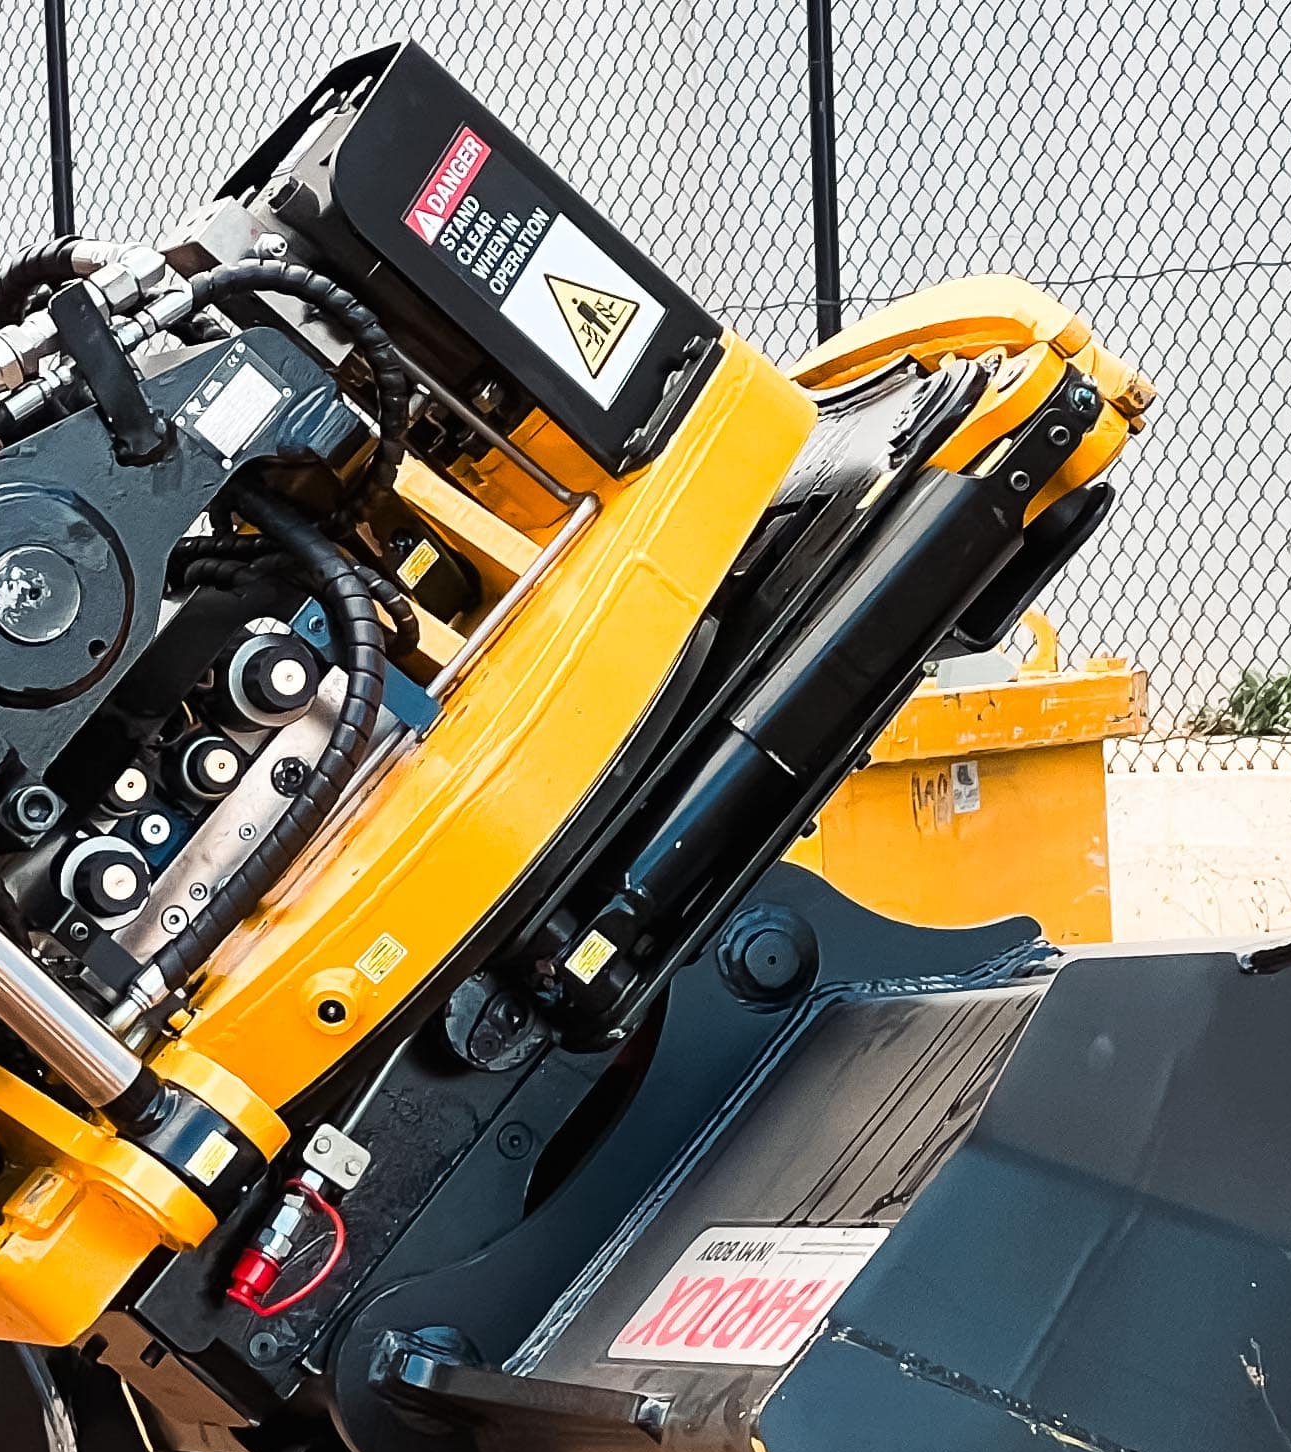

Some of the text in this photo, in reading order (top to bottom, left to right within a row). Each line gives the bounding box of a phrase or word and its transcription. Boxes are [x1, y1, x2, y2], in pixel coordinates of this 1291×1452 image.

[426, 135, 484, 216] DANGER
[439, 195, 480, 251] STAND
[456, 211, 497, 265] CLEAR
[471, 212, 521, 280] WHEN IN
[488, 206, 550, 295] OPERATION
[696, 1240, 740, 1262] BODY
[730, 1241, 761, 1262] MY
[751, 1241, 776, 1262] IN
[621, 1276, 845, 1350] HARDOX
